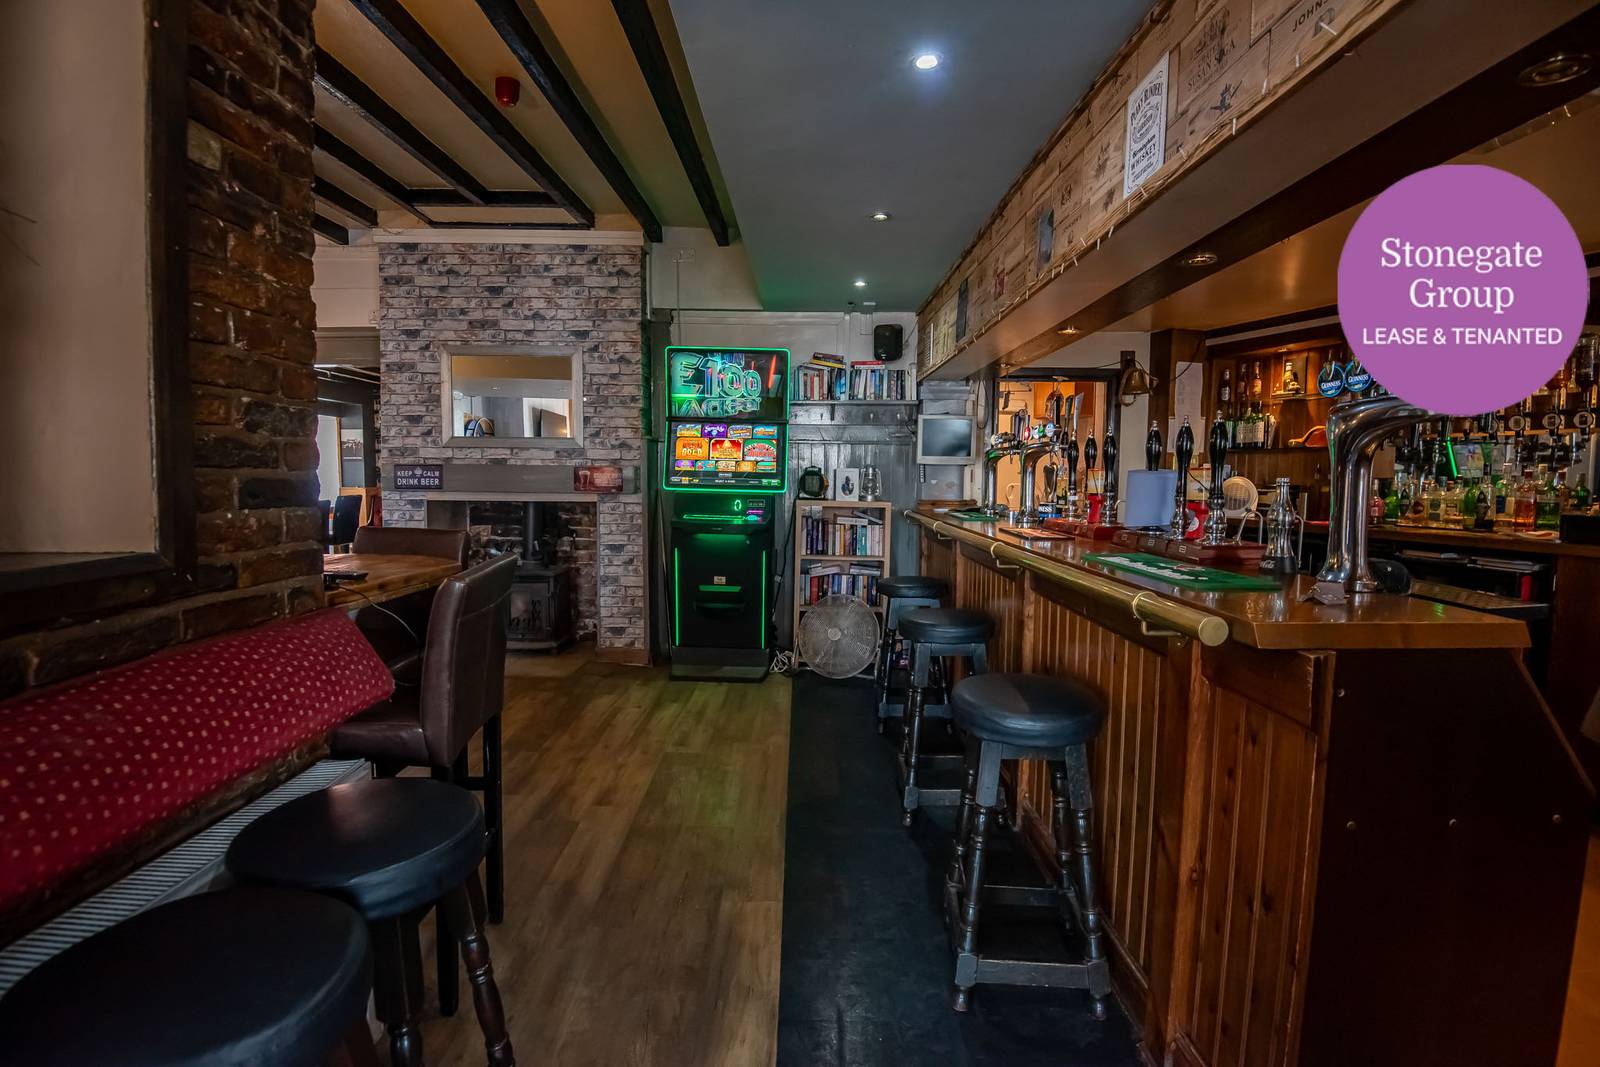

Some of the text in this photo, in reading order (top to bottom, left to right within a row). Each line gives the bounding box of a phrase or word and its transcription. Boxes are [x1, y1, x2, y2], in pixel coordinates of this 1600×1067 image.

[1292, 0, 1328, 32] JOHN
[1131, 142, 1156, 172] WHISKEY
[397, 478, 440, 486] DRINK BEER
